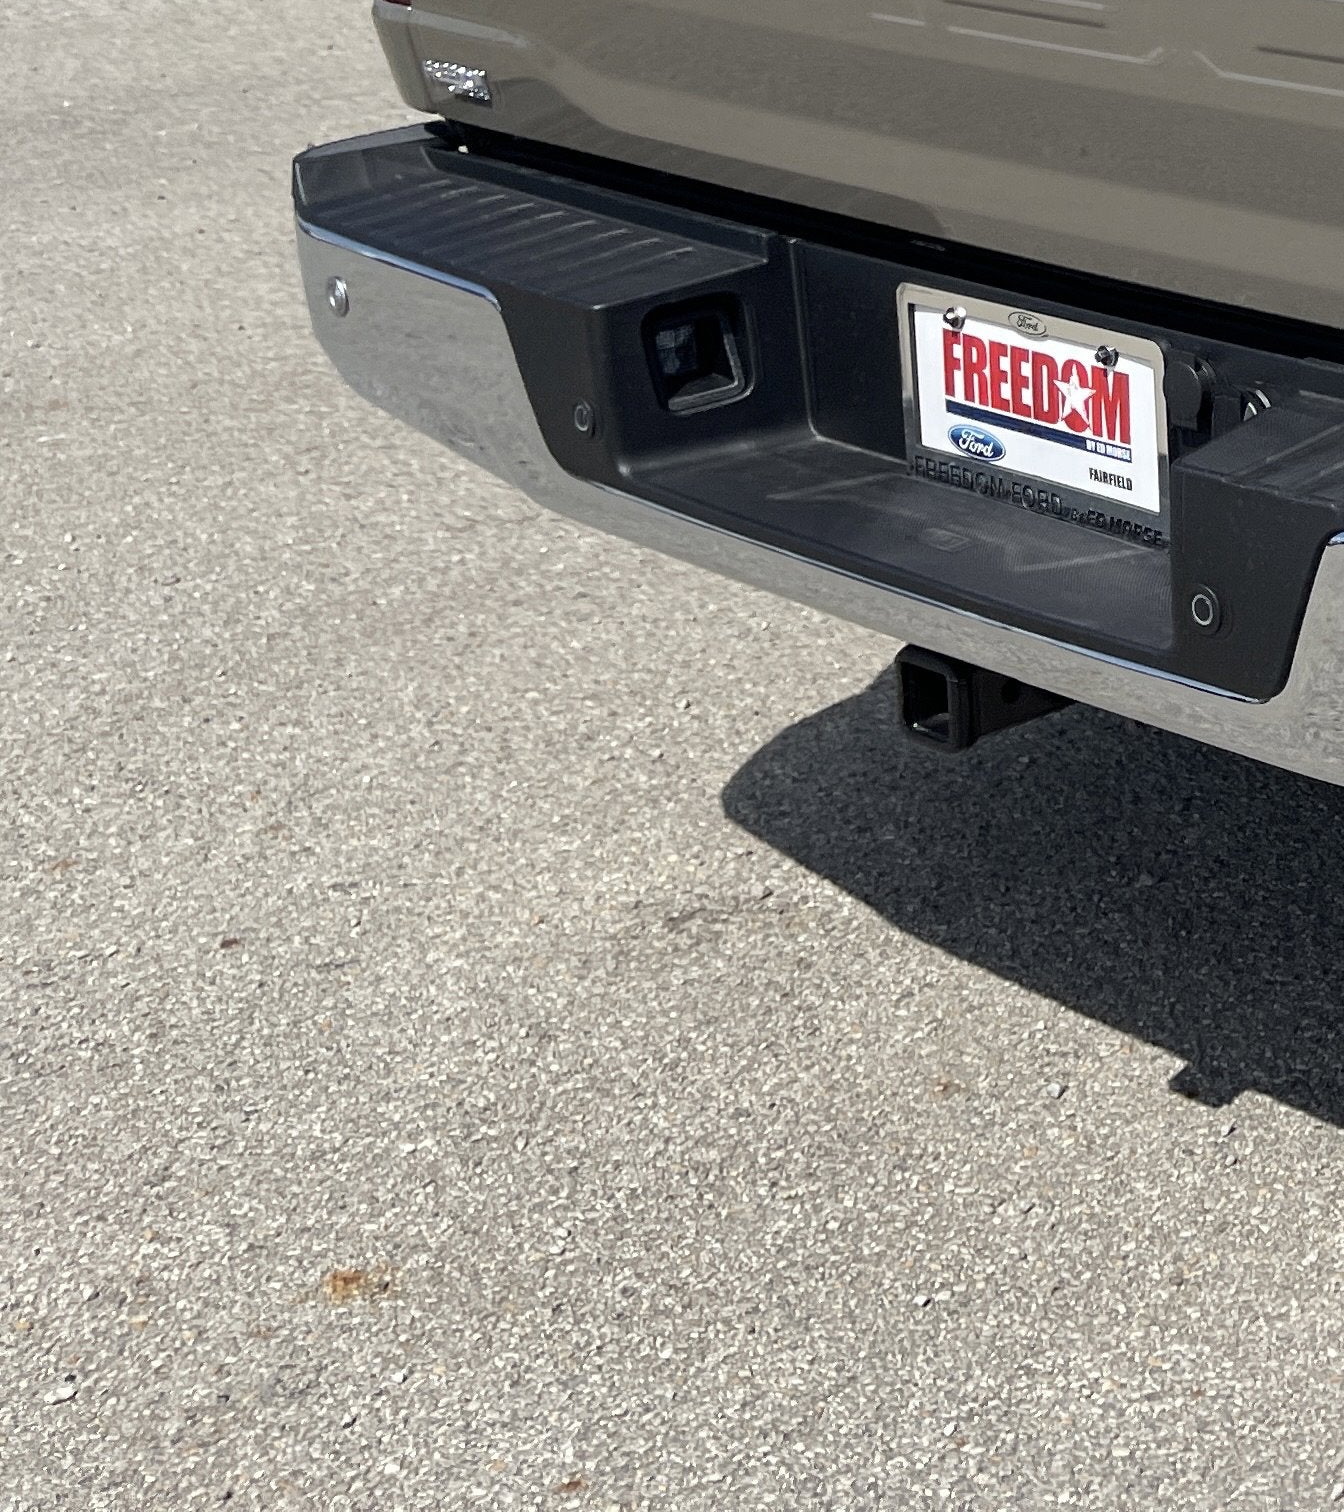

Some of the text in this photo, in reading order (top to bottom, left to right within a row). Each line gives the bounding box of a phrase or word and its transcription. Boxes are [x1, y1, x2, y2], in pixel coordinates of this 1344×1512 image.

[1016, 314, 1039, 332] Ford
[943, 328, 1131, 445] FREEDOM
[958, 429, 994, 457] Ford
[1089, 468, 1132, 491] FAIRFIELD
